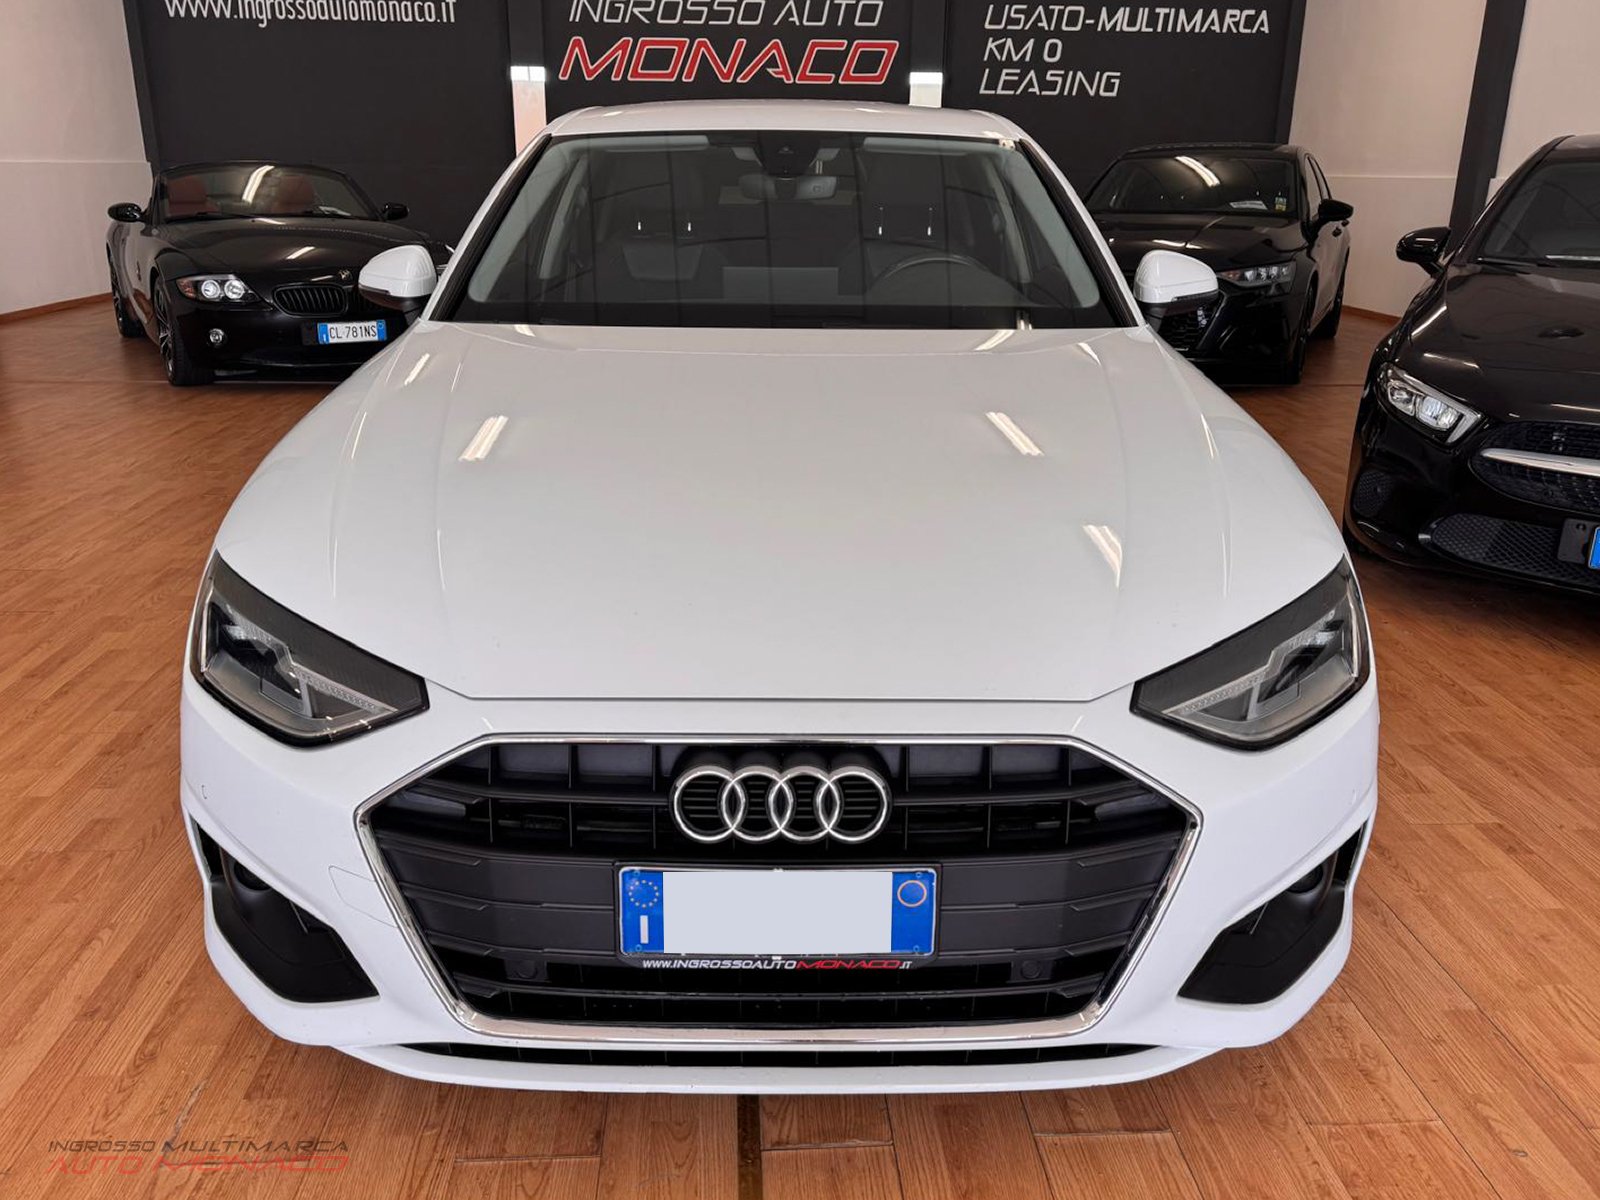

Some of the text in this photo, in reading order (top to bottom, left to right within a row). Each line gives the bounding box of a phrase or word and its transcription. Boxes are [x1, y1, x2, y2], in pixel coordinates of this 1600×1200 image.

[569, 0, 884, 26] INGROSSO AUTO
[984, 4, 1270, 33] USATO-MULTIMARCA
[558, 36, 899, 84] MONACO
[983, 37, 1034, 62] KM
[979, 68, 1121, 97] LEASING
